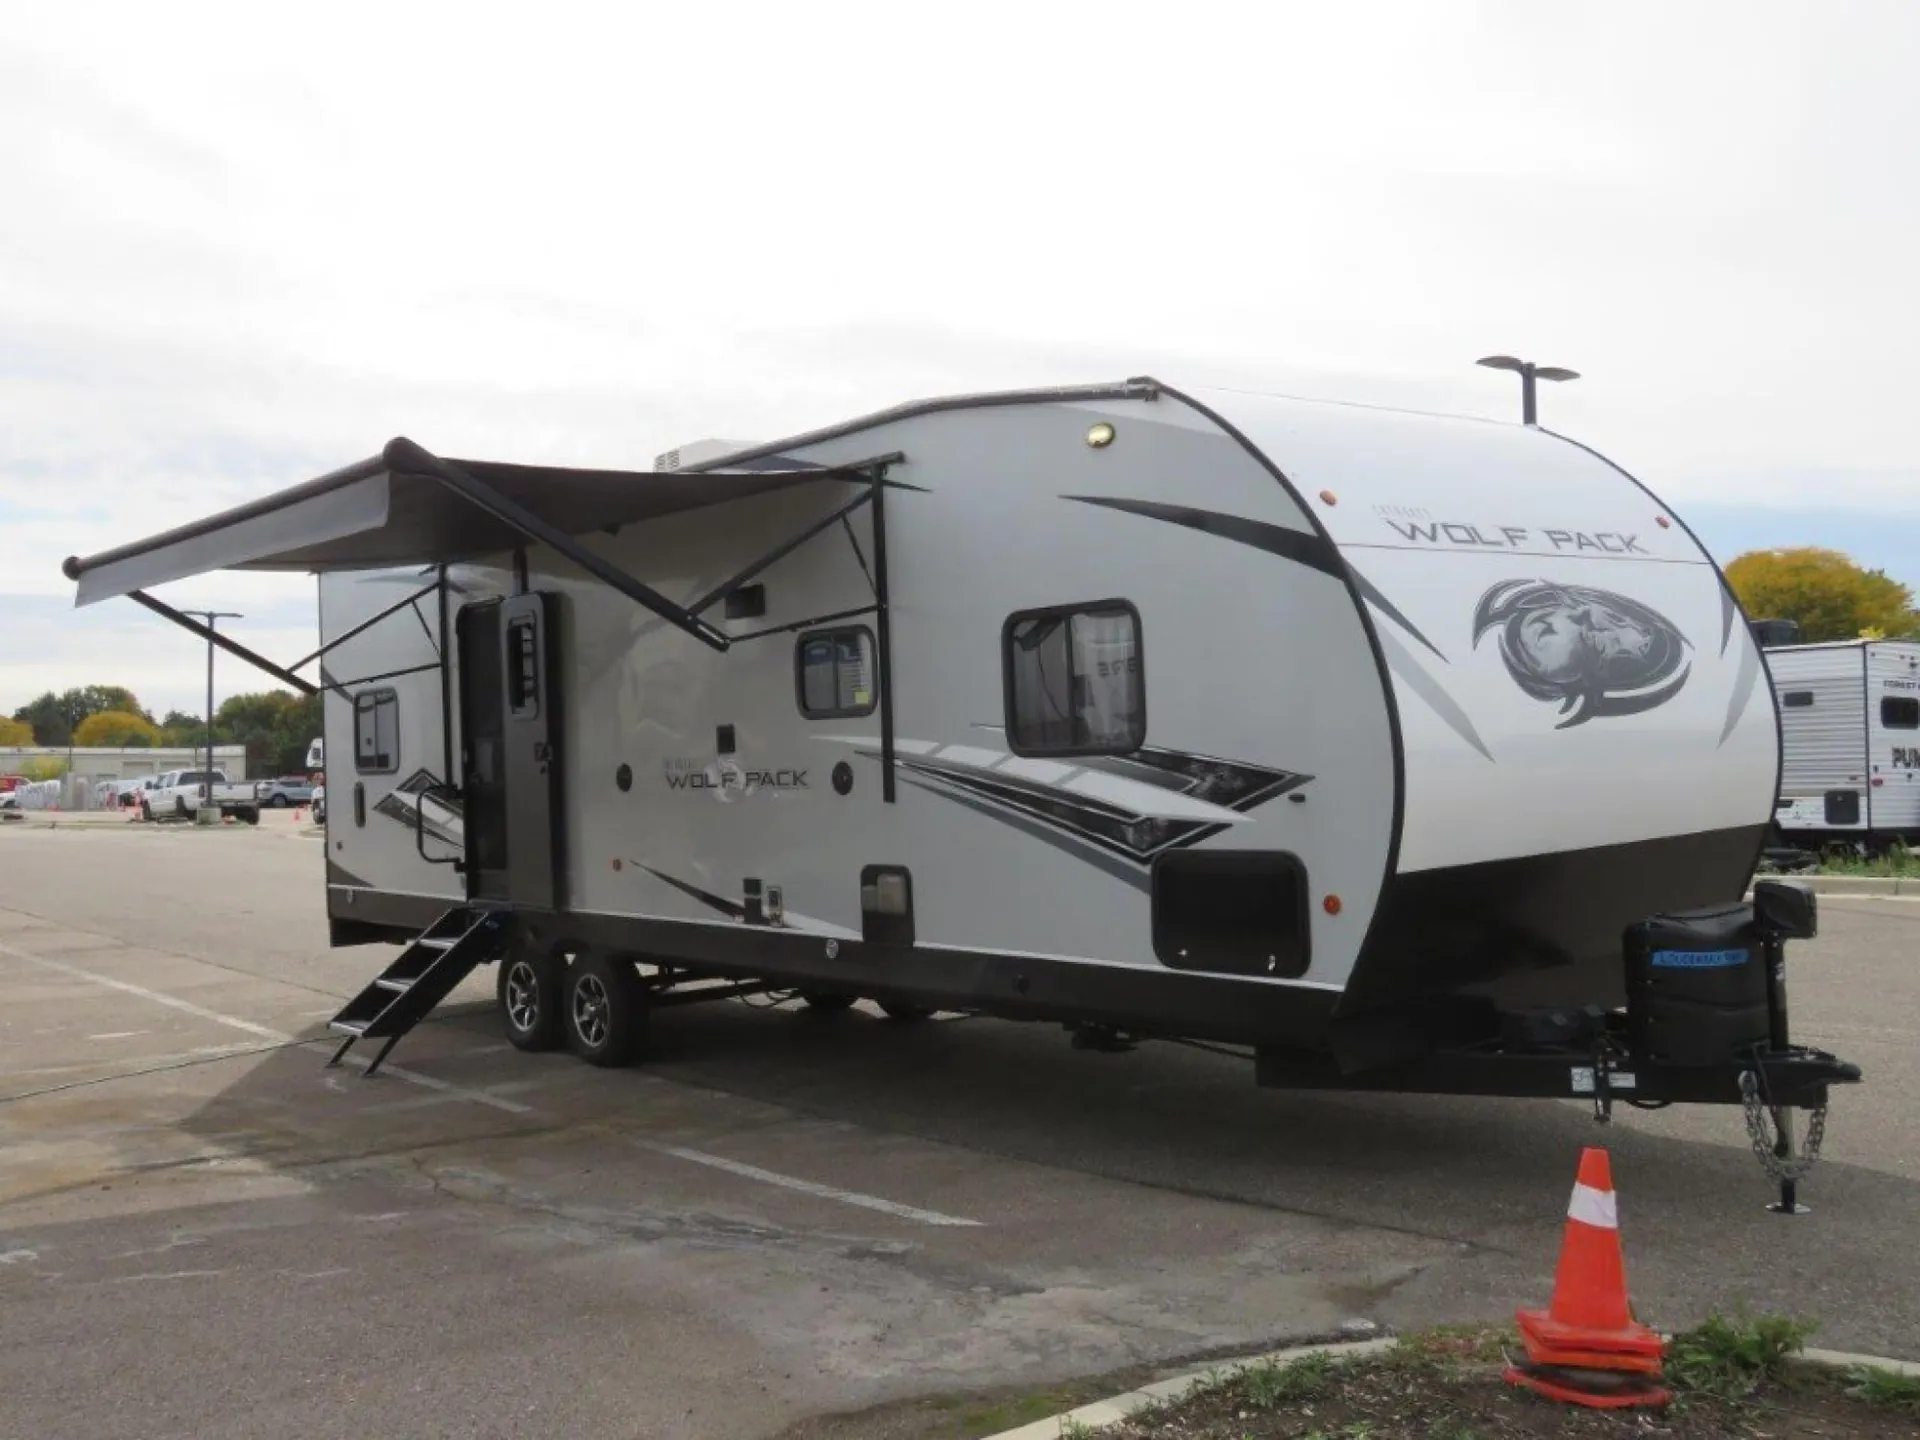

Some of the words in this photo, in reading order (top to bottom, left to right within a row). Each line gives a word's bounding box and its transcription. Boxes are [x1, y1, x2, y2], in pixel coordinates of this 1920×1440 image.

[1386, 520, 1528, 547] WOLF
[1543, 529, 1649, 555] PACK
[665, 772, 738, 789] WOLF
[745, 770, 808, 788] PACK
